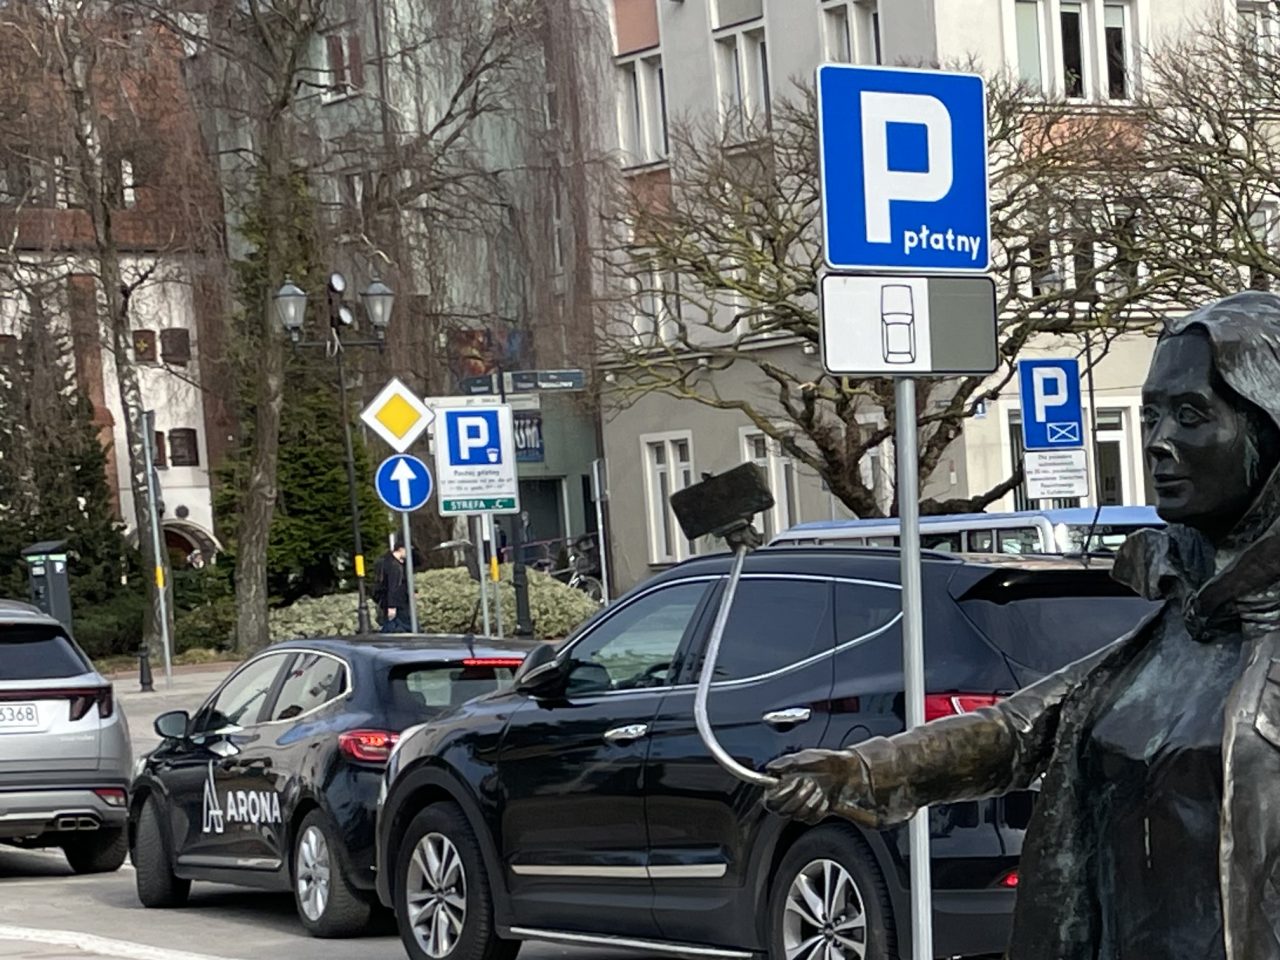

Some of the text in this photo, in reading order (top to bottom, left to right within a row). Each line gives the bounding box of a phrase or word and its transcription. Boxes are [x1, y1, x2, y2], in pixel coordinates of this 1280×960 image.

[860, 90, 953, 244] P
[904, 225, 981, 261] płatny
[1032, 367, 1068, 423] P
[457, 416, 490, 460] P
[450, 500, 486, 511] STREFA
[226, 790, 282, 824] ARONA
